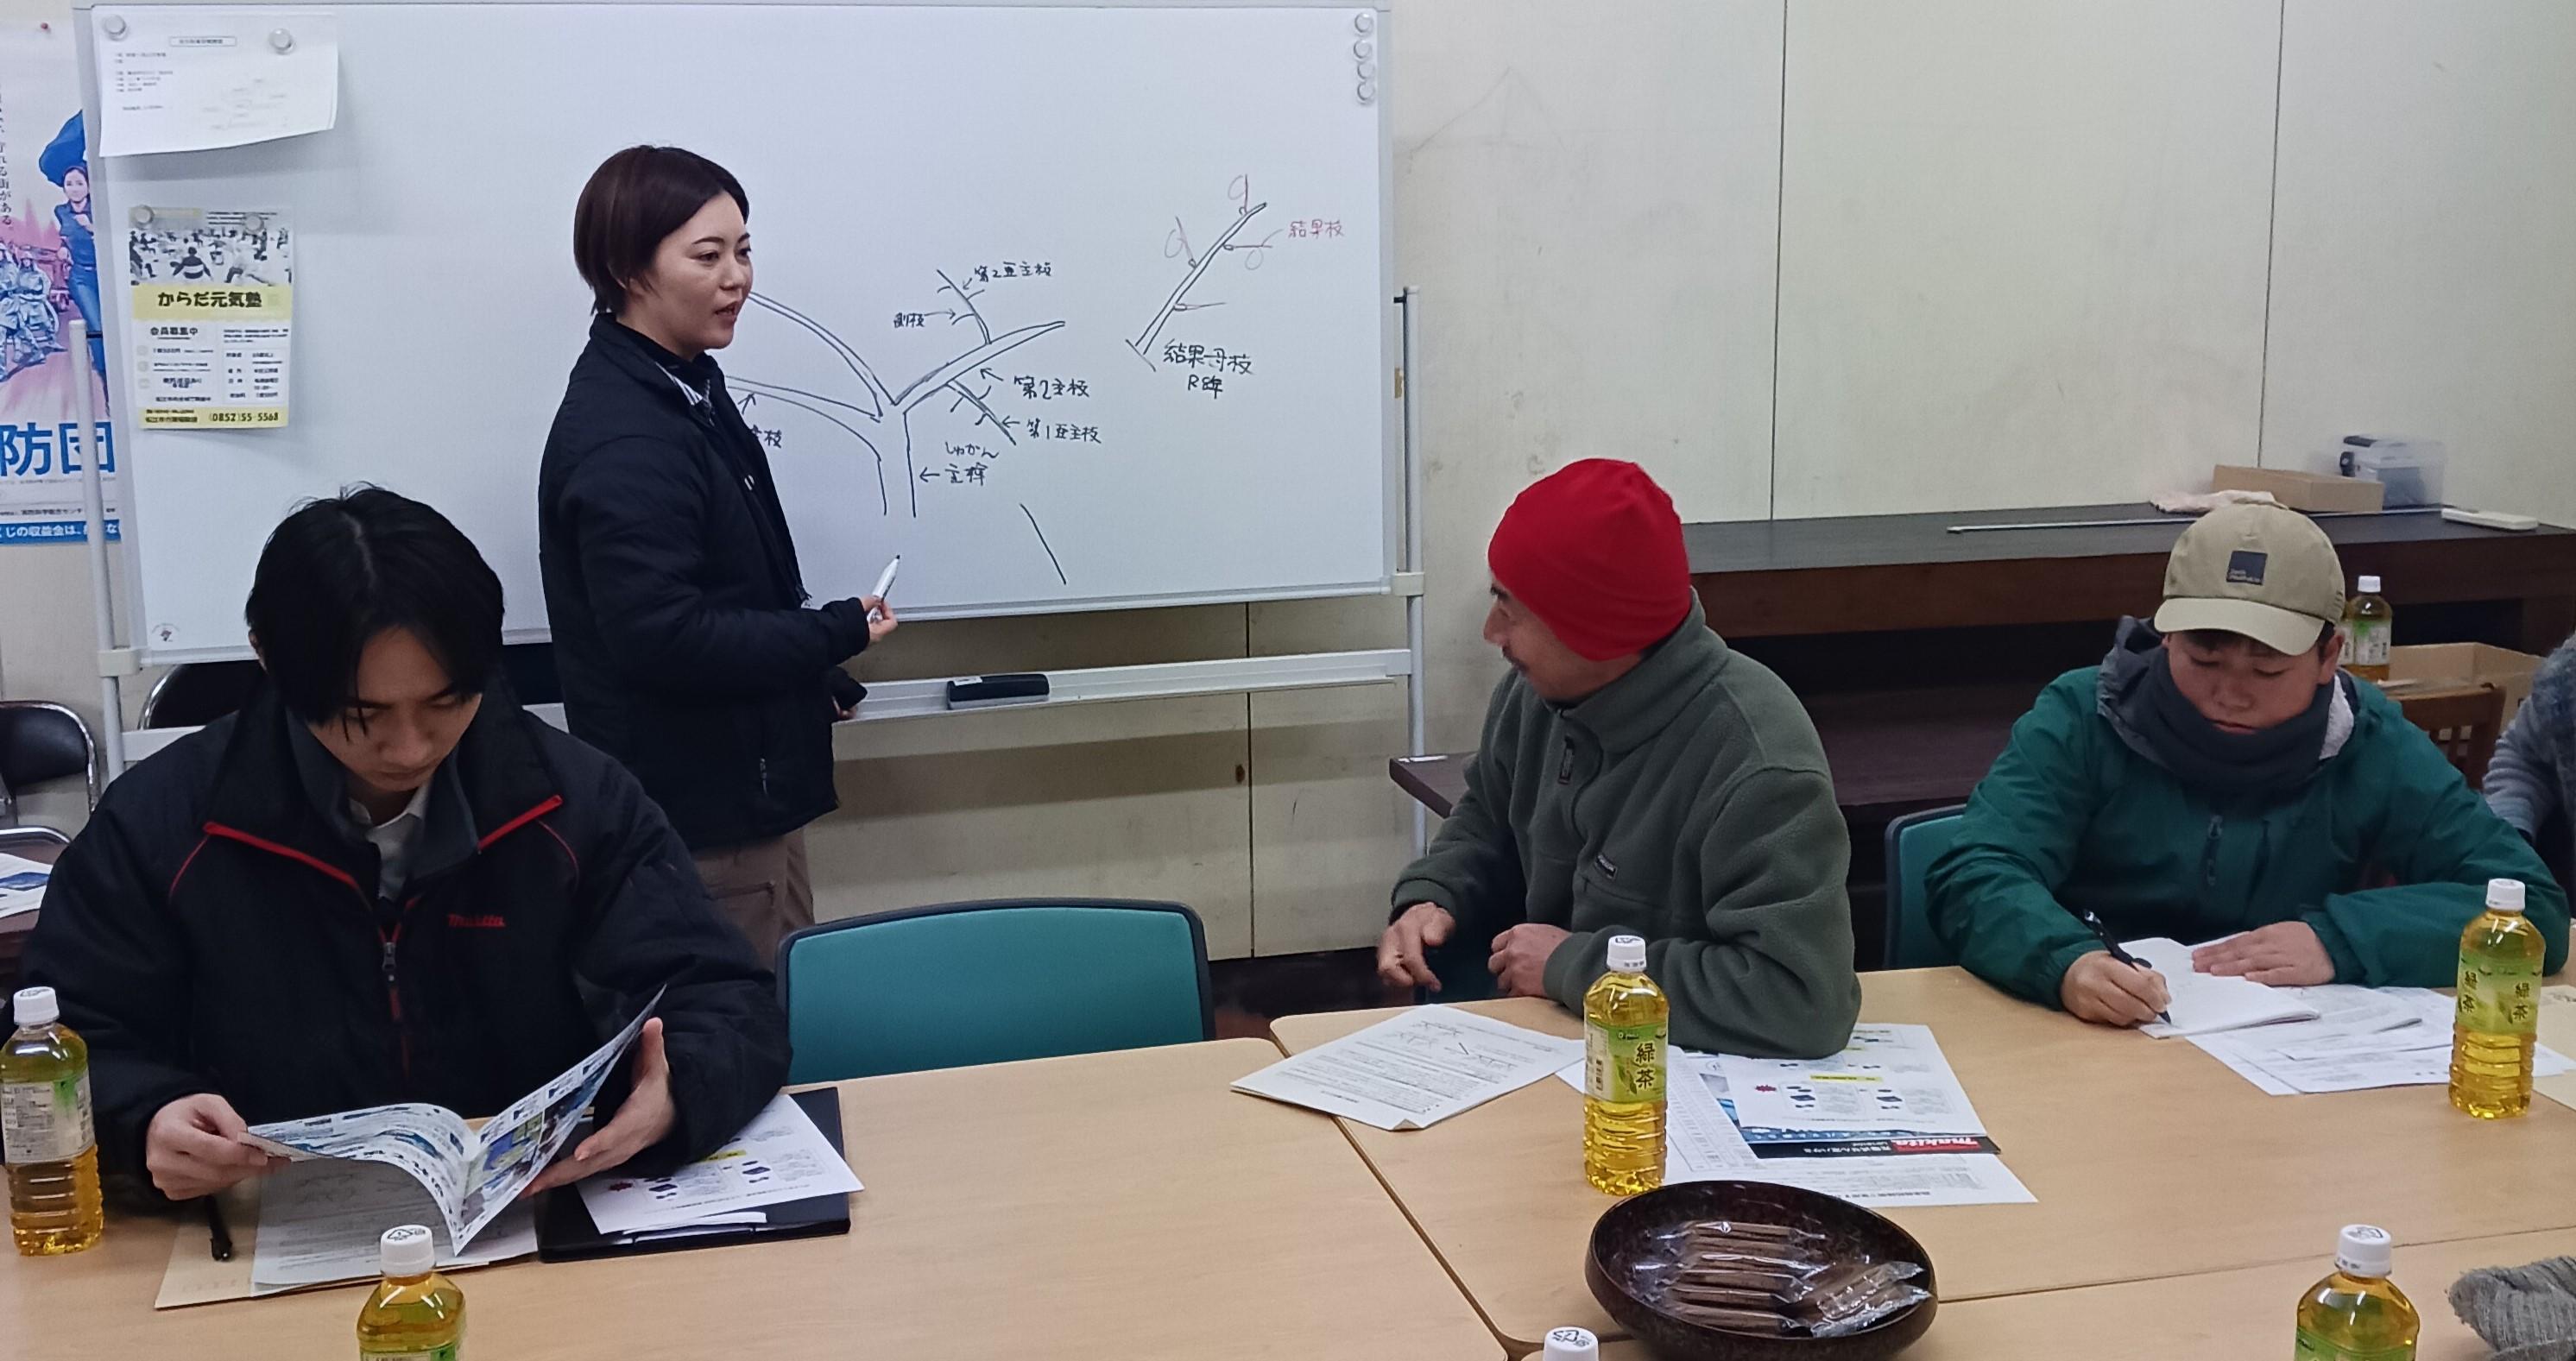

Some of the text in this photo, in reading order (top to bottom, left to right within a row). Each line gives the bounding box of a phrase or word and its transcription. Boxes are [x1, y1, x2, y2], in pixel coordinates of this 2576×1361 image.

[158, 292, 262, 308] からだ元気塾
[1636, 1043, 1656, 1089] 緑茶
